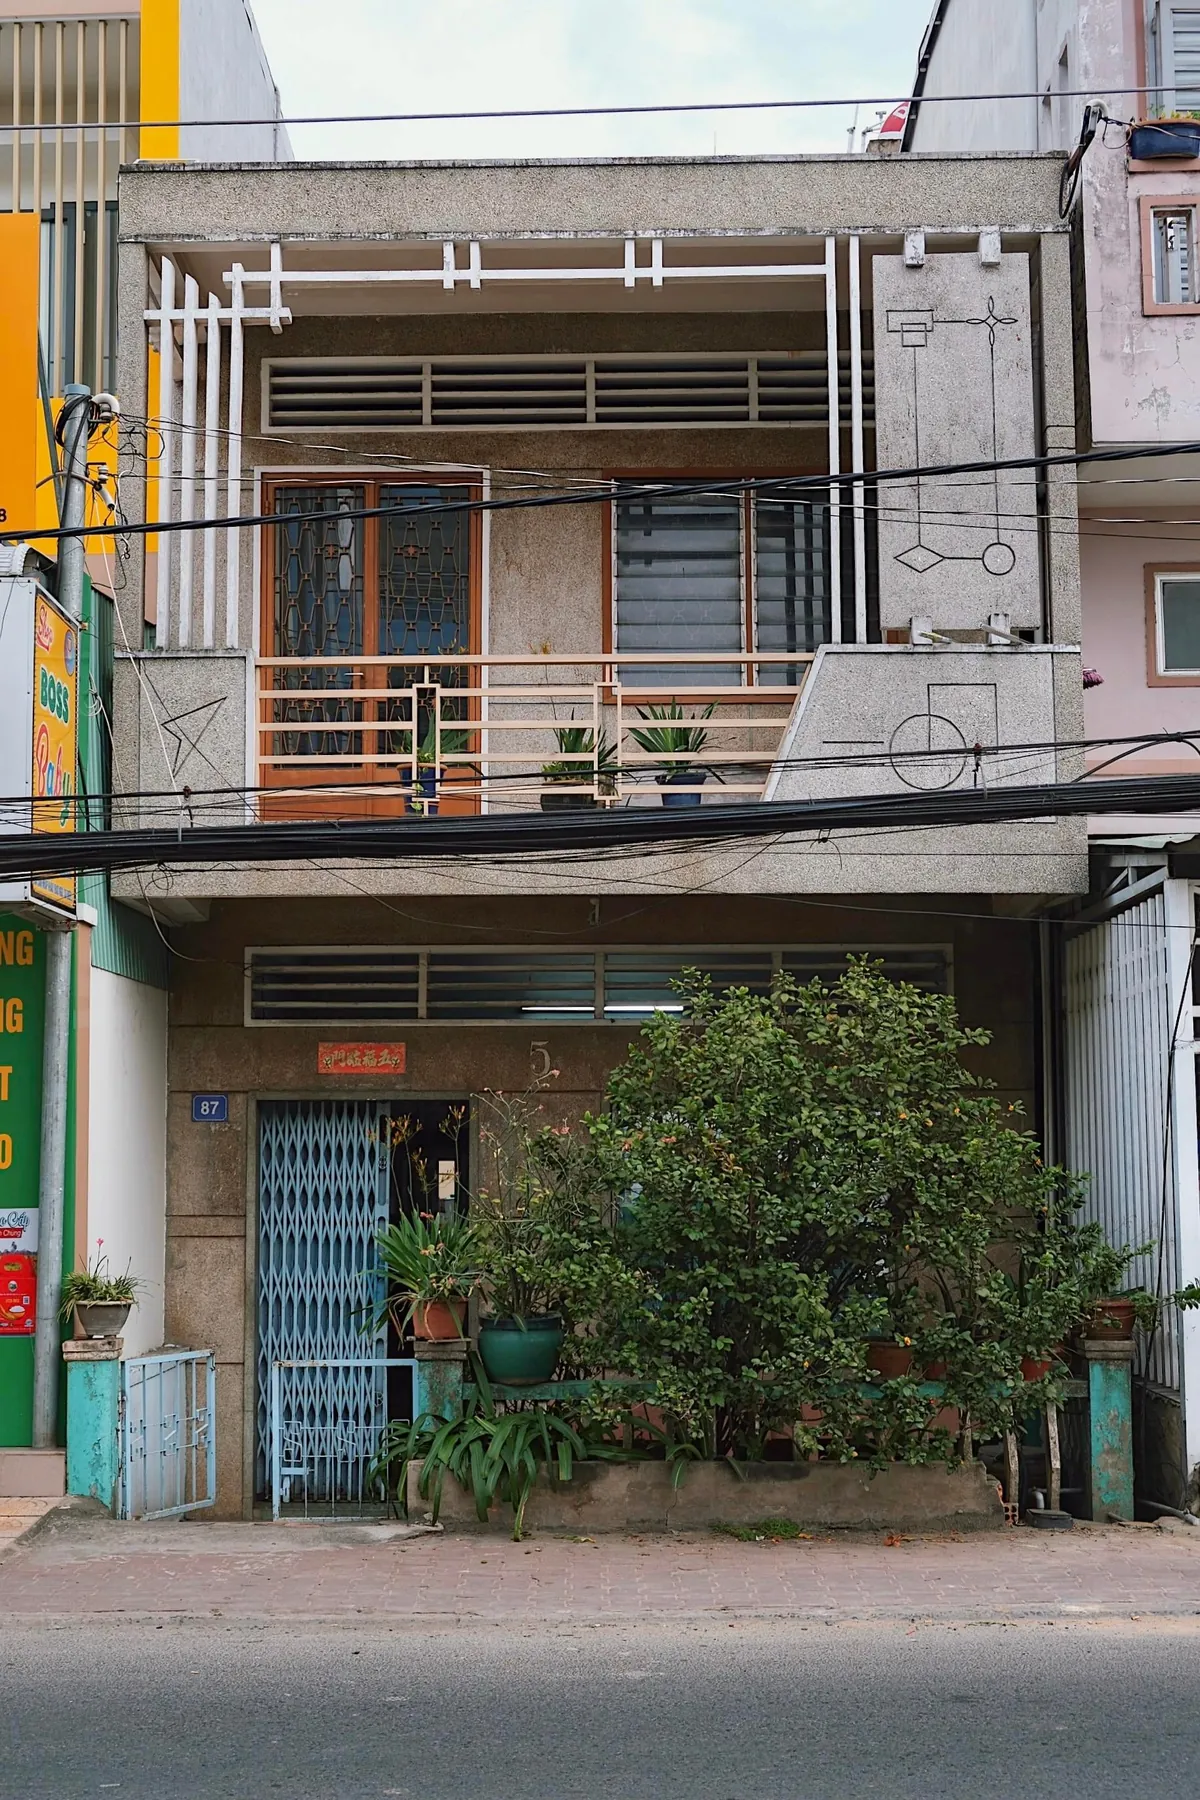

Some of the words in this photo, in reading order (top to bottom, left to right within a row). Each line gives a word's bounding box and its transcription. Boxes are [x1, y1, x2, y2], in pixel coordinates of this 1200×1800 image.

[40, 666, 70, 724] BOSS
[0, 997, 23, 1033] G
[530, 1040, 551, 1077] 5
[200, 1101, 219, 1115] 87
